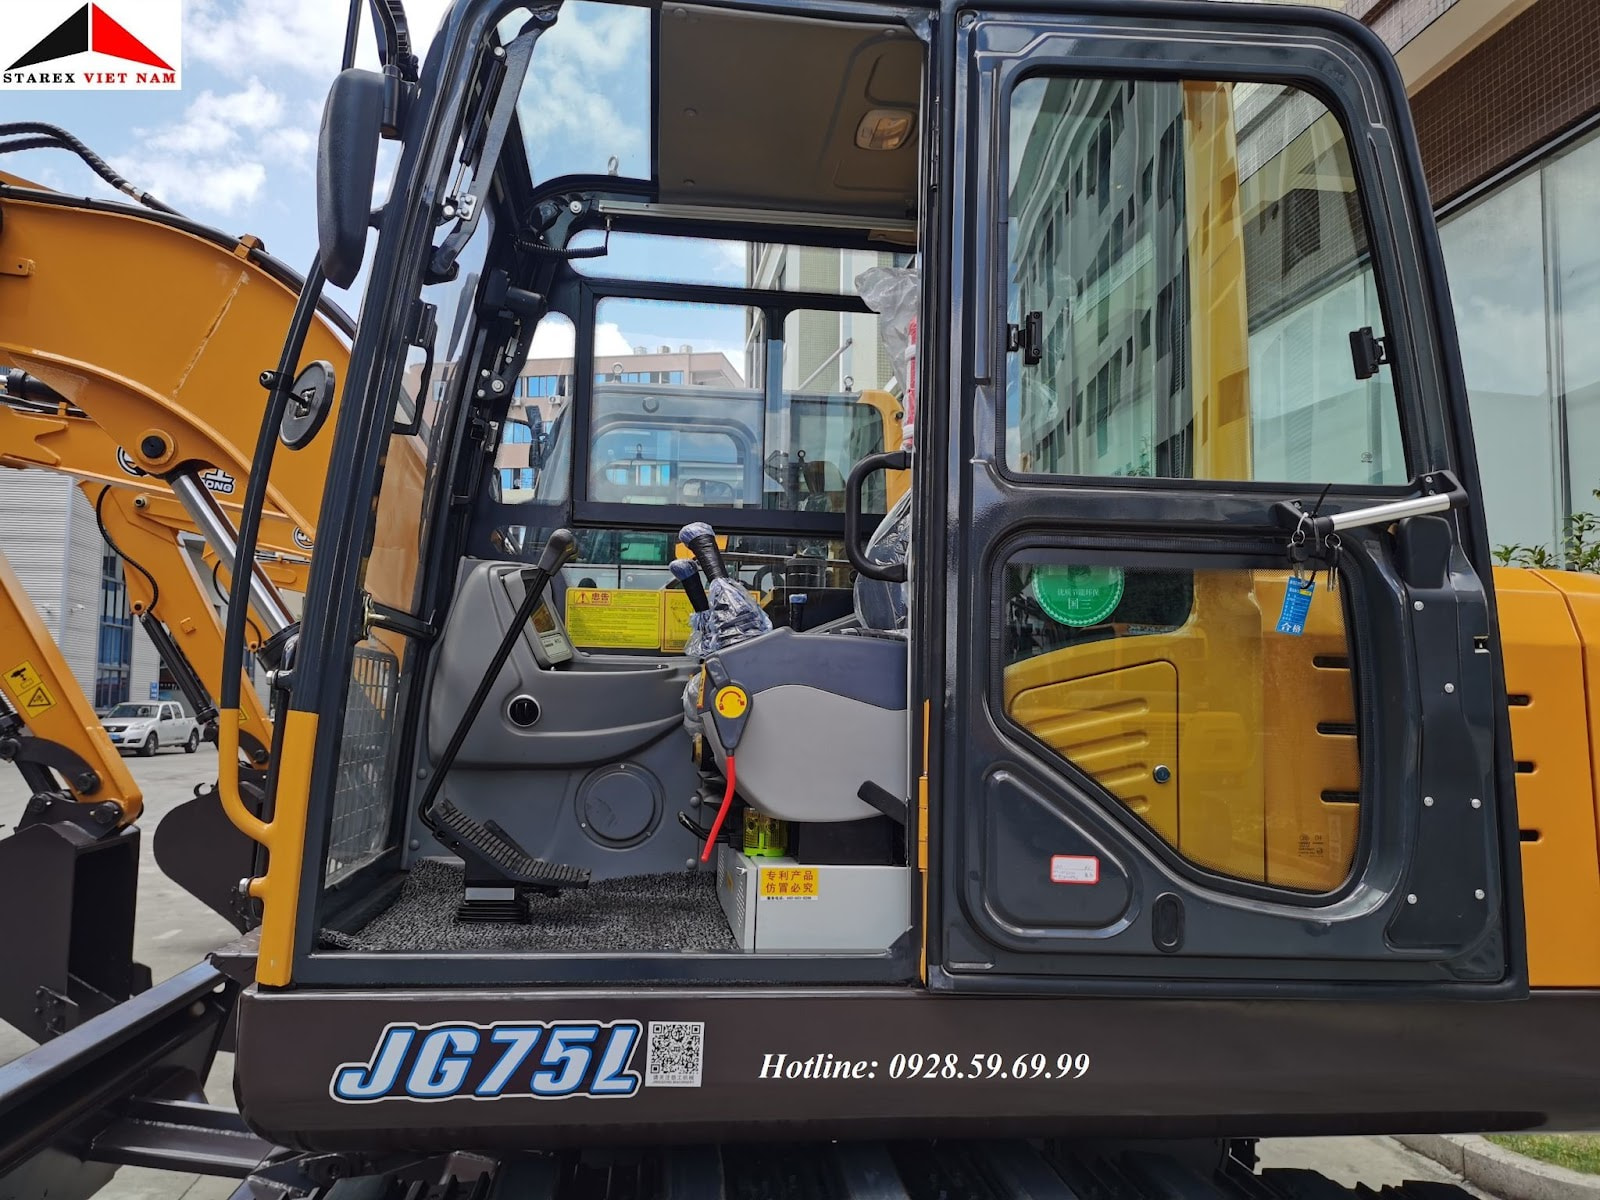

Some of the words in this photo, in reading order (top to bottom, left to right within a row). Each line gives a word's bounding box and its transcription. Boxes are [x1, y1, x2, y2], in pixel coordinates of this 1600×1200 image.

[205, 480, 233, 492] ONG
[766, 870, 813, 881] 专利产品
[336, 1024, 638, 1097] JG75L
